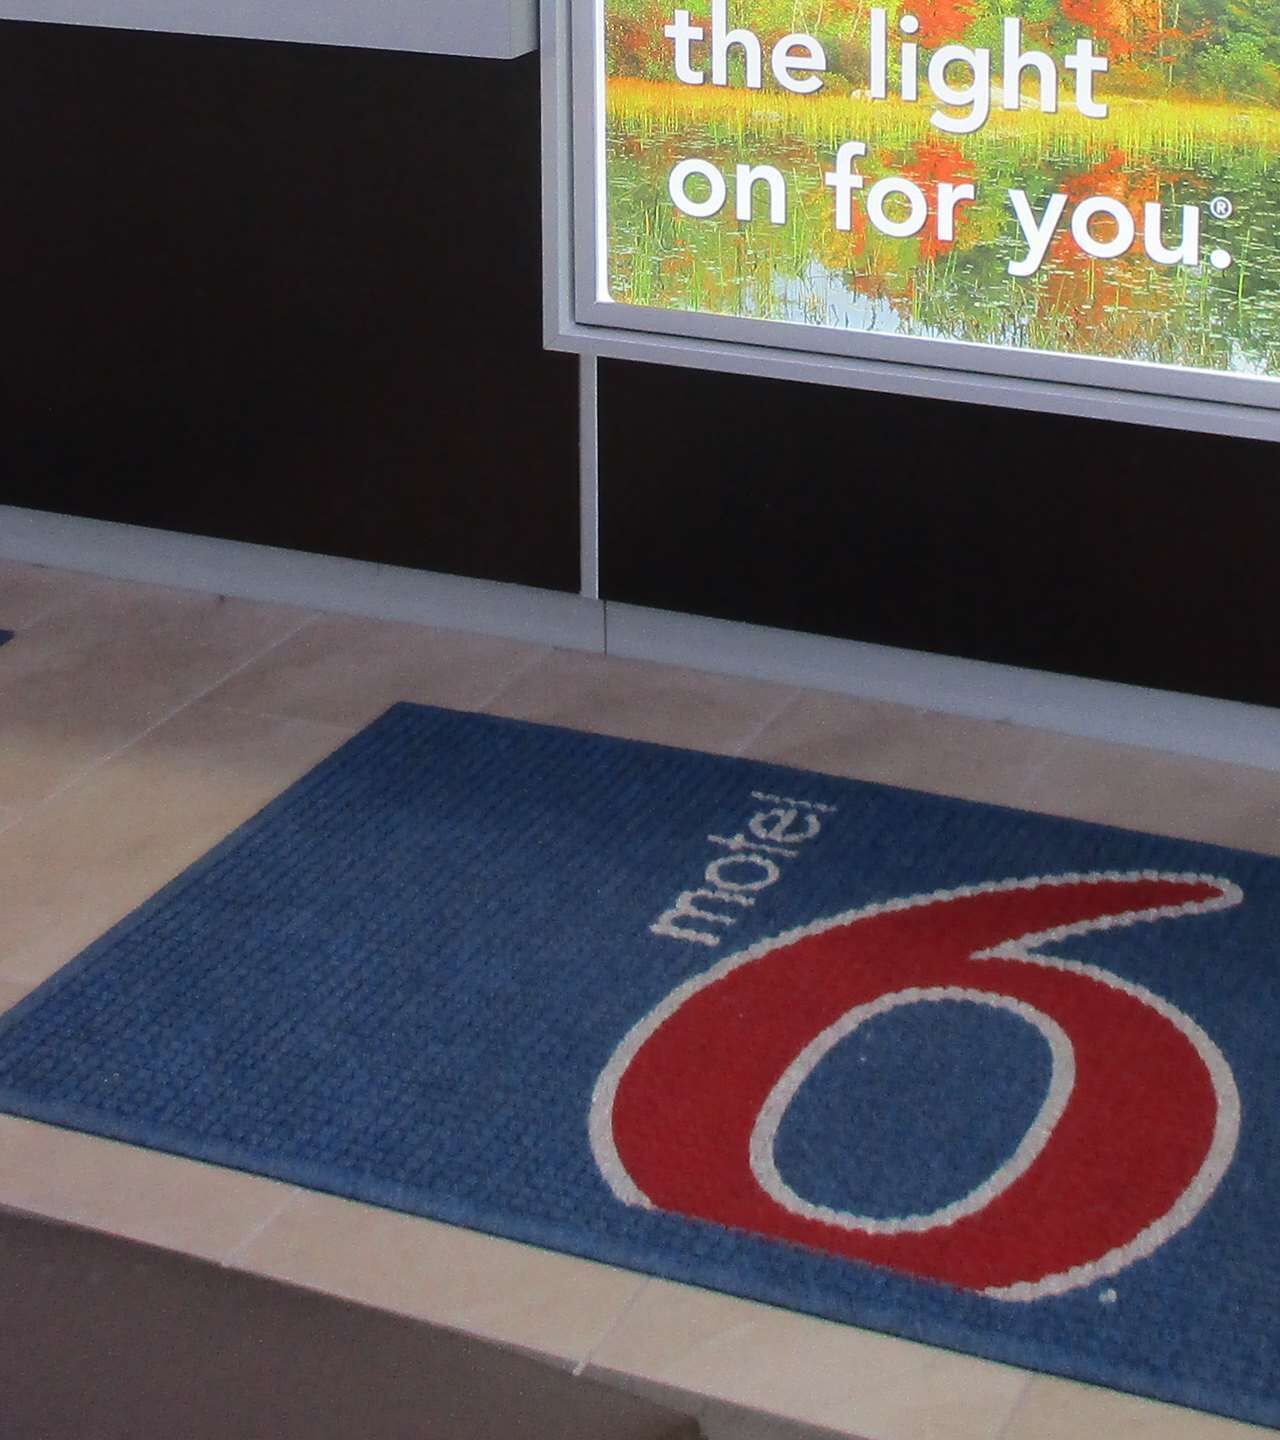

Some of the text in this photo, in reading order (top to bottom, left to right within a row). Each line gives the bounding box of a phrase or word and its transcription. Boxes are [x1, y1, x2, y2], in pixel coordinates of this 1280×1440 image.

[870, 7, 1108, 134] light
[668, 158, 788, 225] on
[825, 142, 975, 241] for
[650, 790, 838, 947] motel
[588, 870, 1244, 1303] 6
